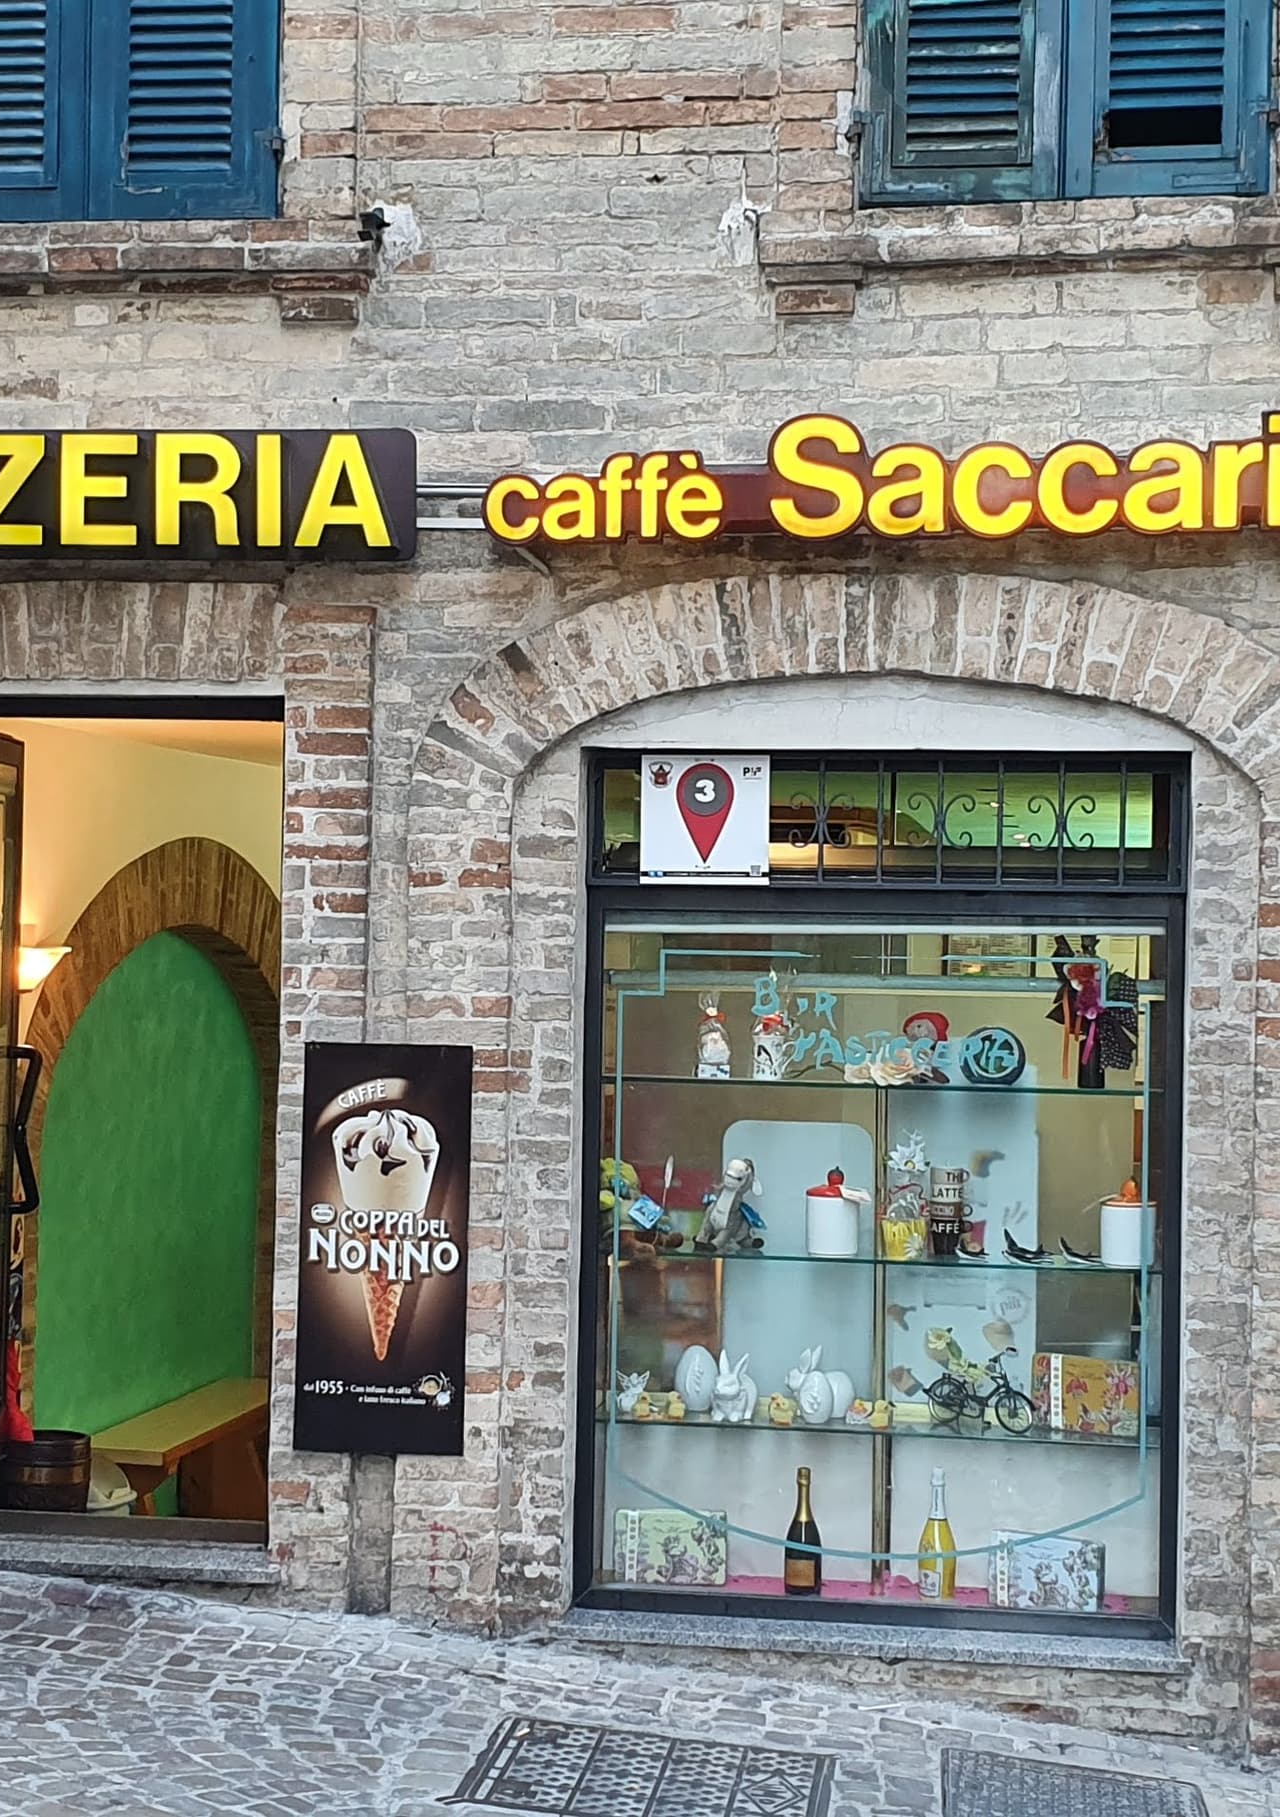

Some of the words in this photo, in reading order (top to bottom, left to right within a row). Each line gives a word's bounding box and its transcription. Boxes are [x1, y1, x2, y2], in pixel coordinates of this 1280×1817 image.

[484, 452, 722, 541] caffè
[694, 778, 717, 803] 3
[337, 1079, 388, 1108] CAFFÈ
[340, 1210, 414, 1236] COPPA
[417, 1219, 450, 1239] DEL
[930, 1222, 961, 1234] AFFE
[308, 1228, 460, 1281] NONNO
[315, 1380, 344, 1394] 1955
